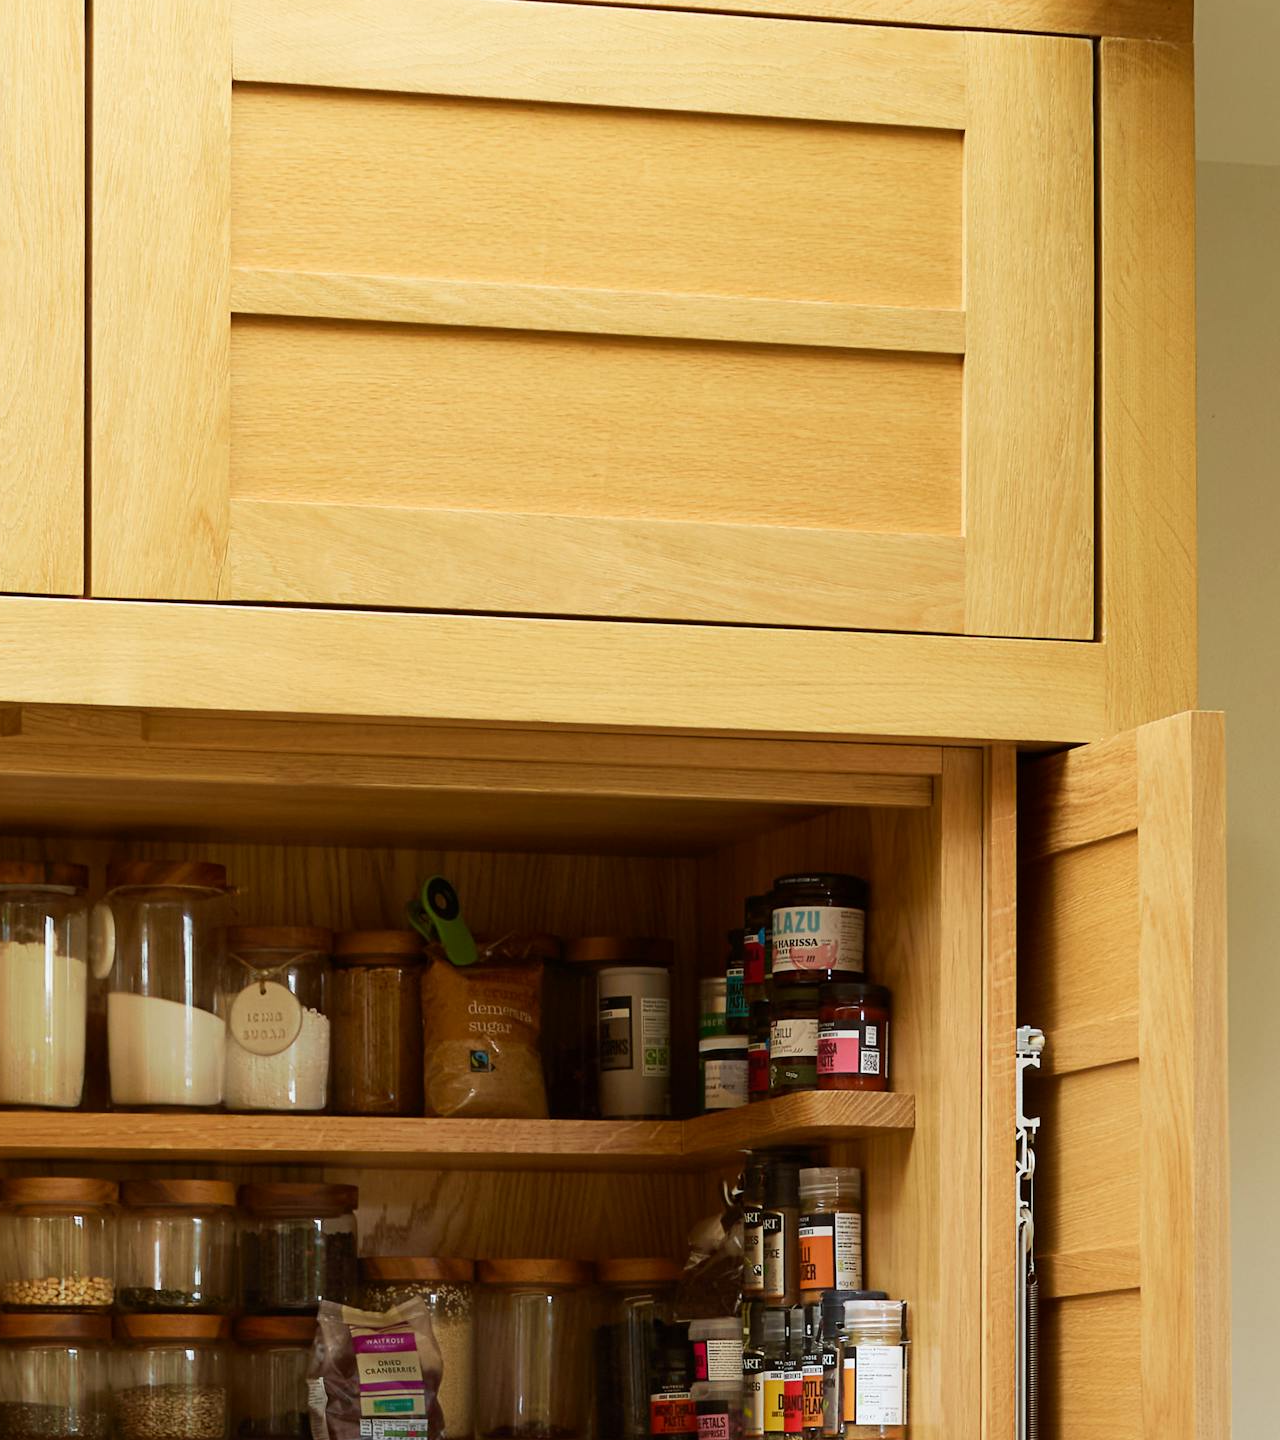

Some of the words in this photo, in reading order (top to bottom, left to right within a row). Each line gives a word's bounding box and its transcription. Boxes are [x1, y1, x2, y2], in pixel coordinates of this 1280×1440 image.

[773, 910, 821, 935] ELAZU
[467, 1000, 533, 1023] demerara
[468, 1020, 513, 1036] sugar
[365, 1337, 405, 1346] WAITROSE
[377, 1359, 402, 1367] DRIED
[365, 1366, 418, 1376] CRANBERRIES
